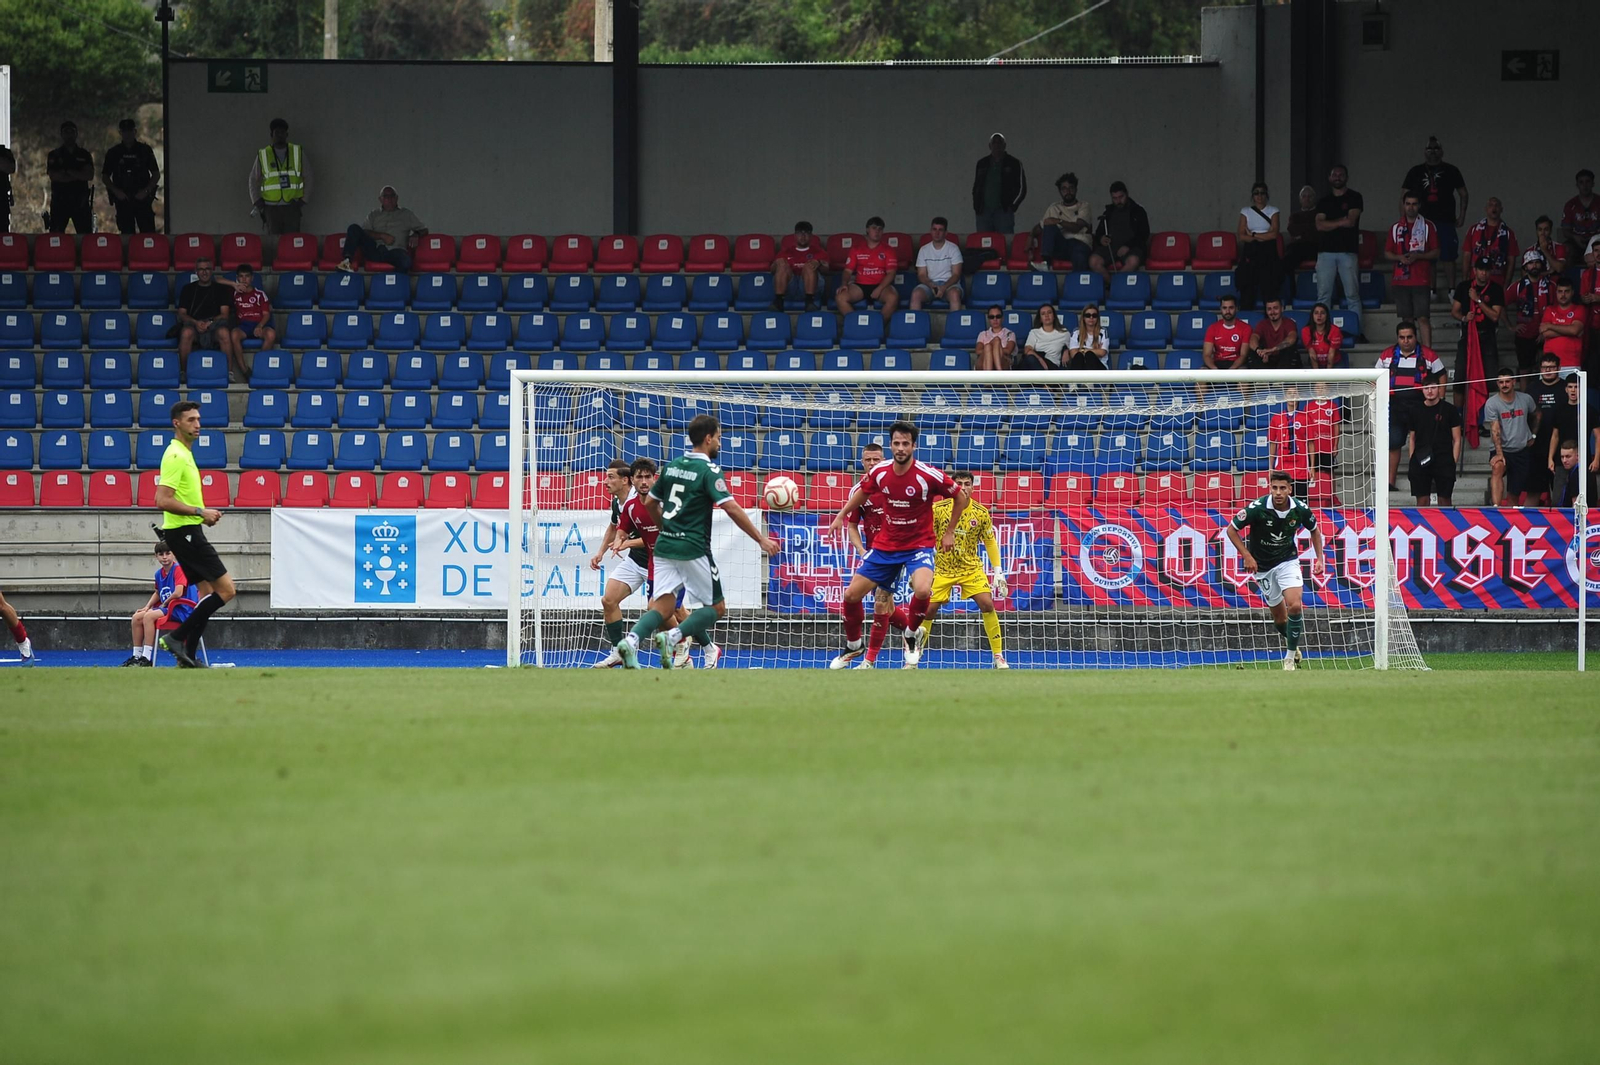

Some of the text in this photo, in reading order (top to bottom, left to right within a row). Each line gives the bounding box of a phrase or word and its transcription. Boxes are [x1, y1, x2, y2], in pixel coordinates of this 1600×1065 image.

[662, 483, 686, 520] 5
[1101, 525, 1139, 550] DEPORTIVA
[442, 565, 493, 597] DE
